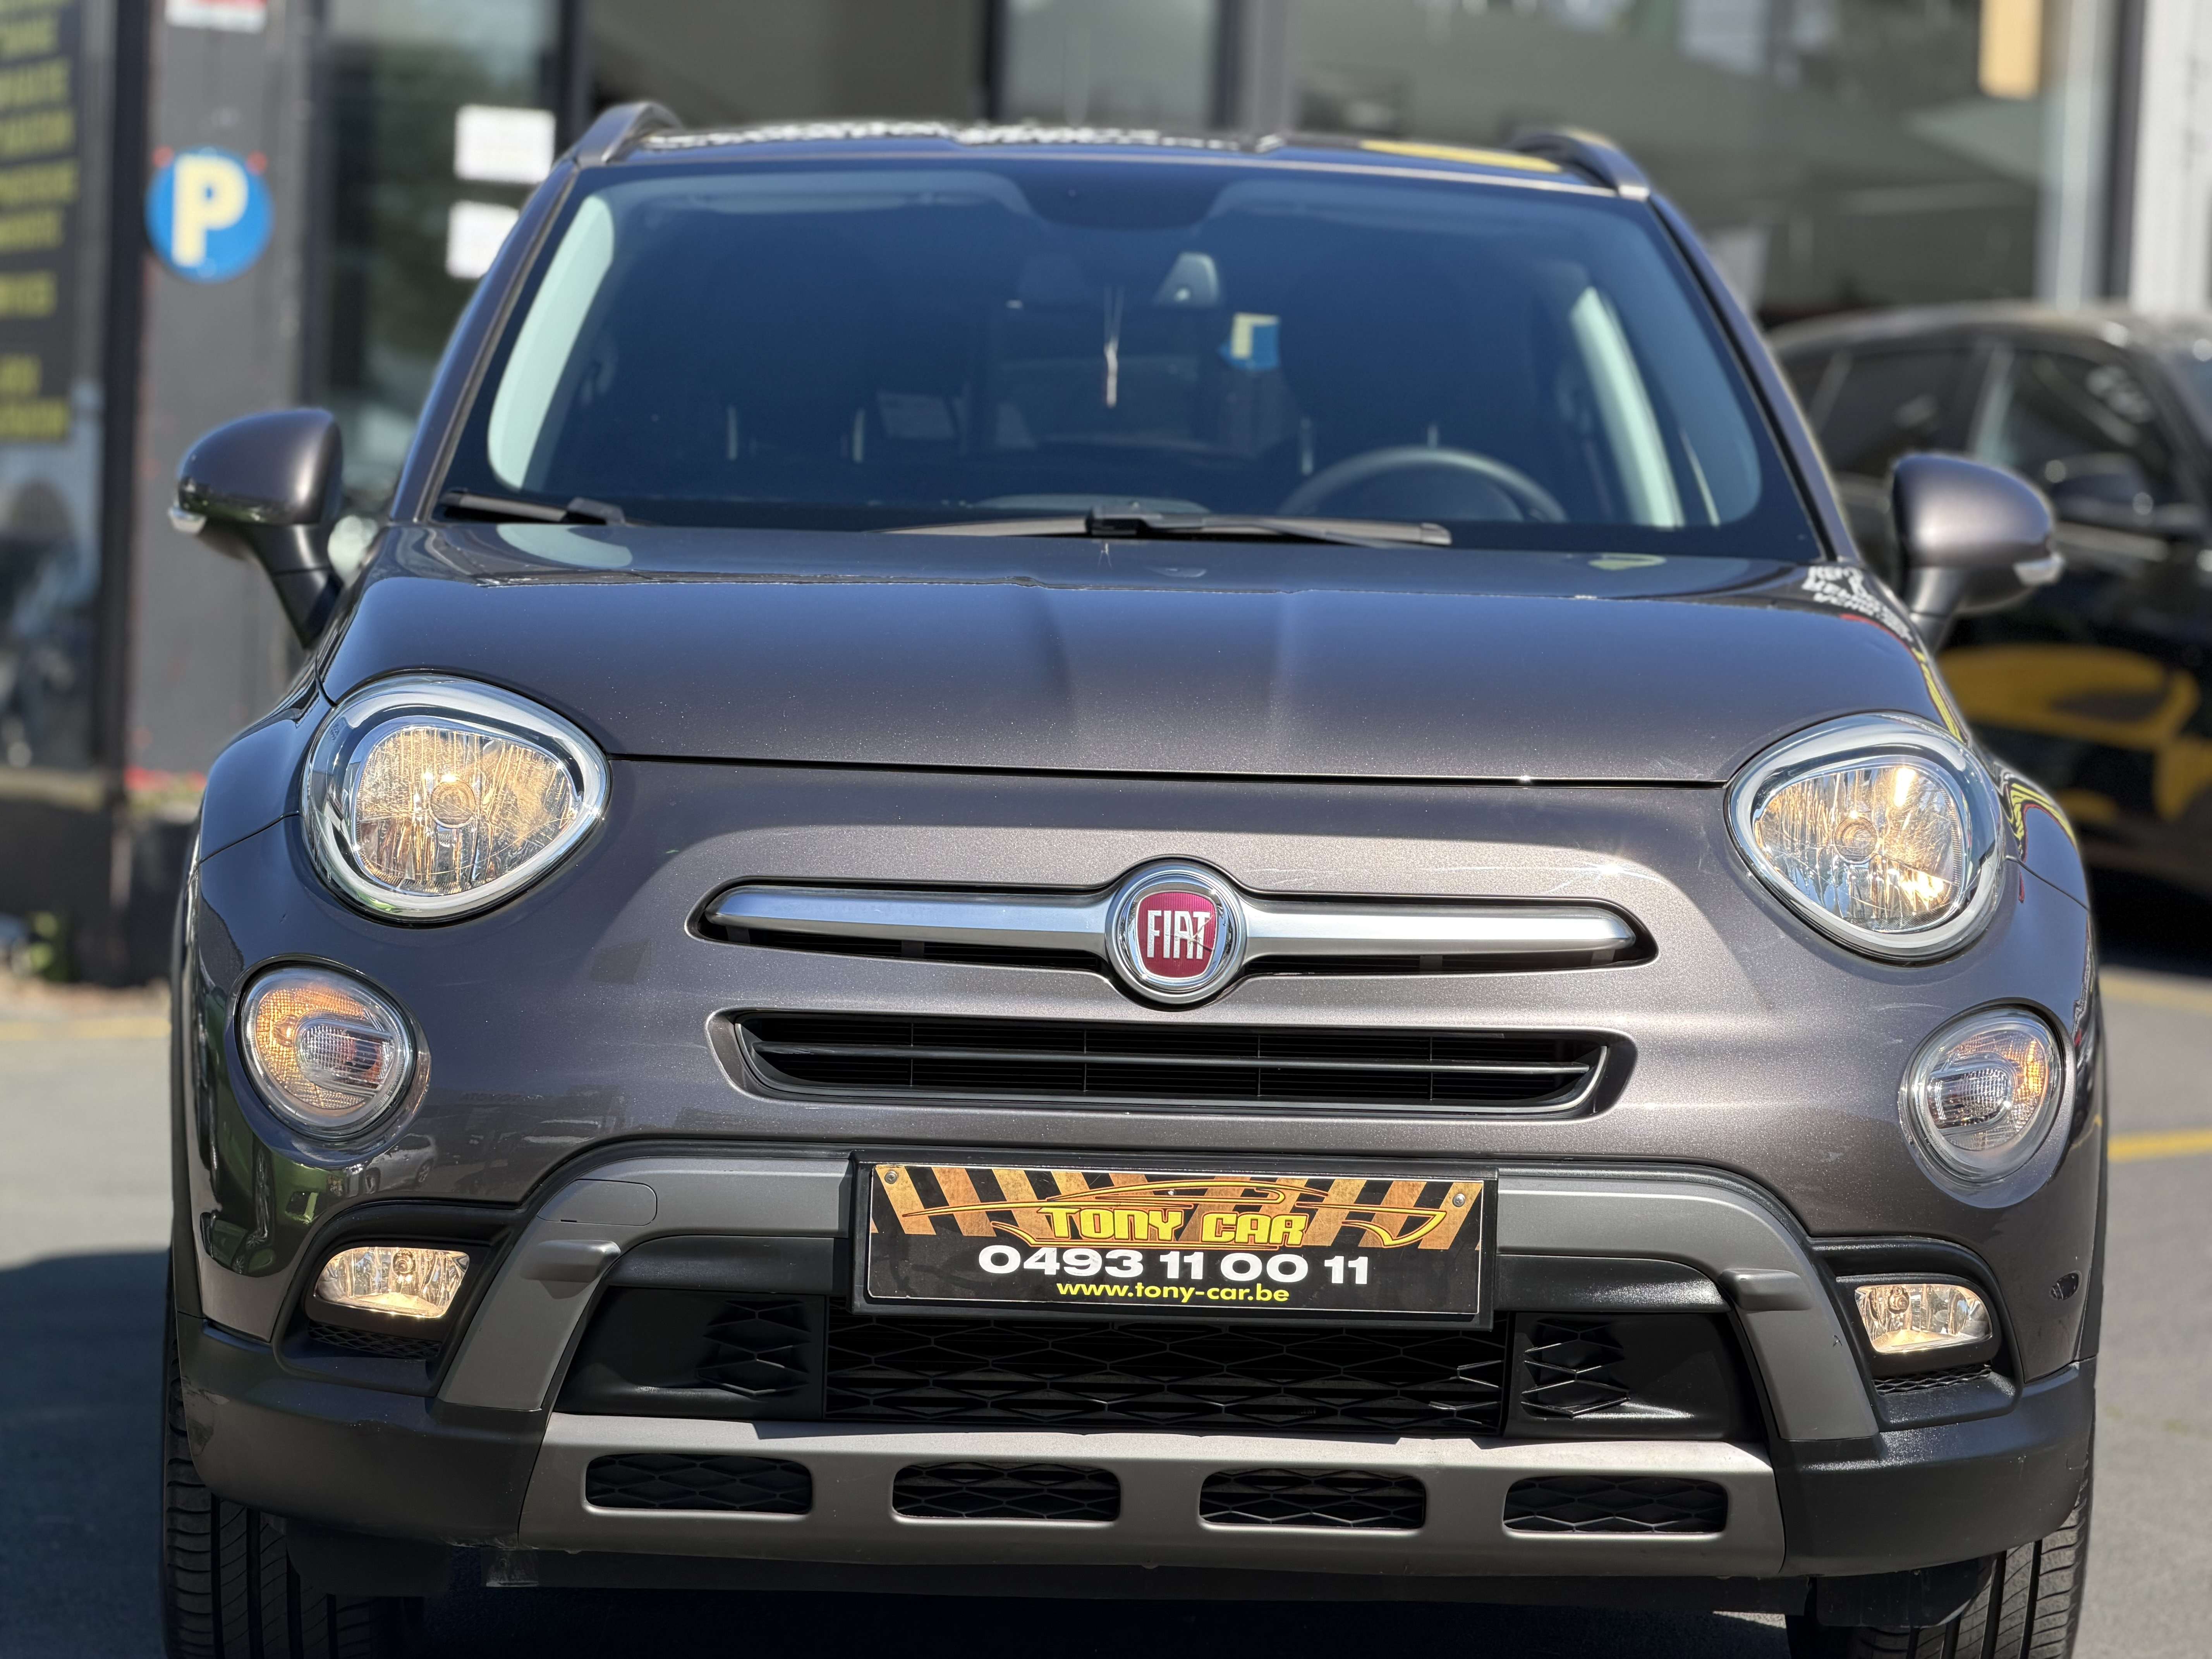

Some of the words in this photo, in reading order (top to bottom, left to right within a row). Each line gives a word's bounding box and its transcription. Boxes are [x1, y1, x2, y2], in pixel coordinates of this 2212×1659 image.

[172, 154, 249, 266] P
[1147, 910, 1211, 960] FIAT
[1037, 1207, 1182, 1241] TONY
[1202, 1213, 1308, 1245] CAR
[978, 1245, 1144, 1278] 0493
[1159, 1250, 1204, 1280] 11
[1221, 1252, 1309, 1283] 00
[1324, 1255, 1369, 1285] 11
[1056, 1282, 1290, 1303] www.tony-car.be
